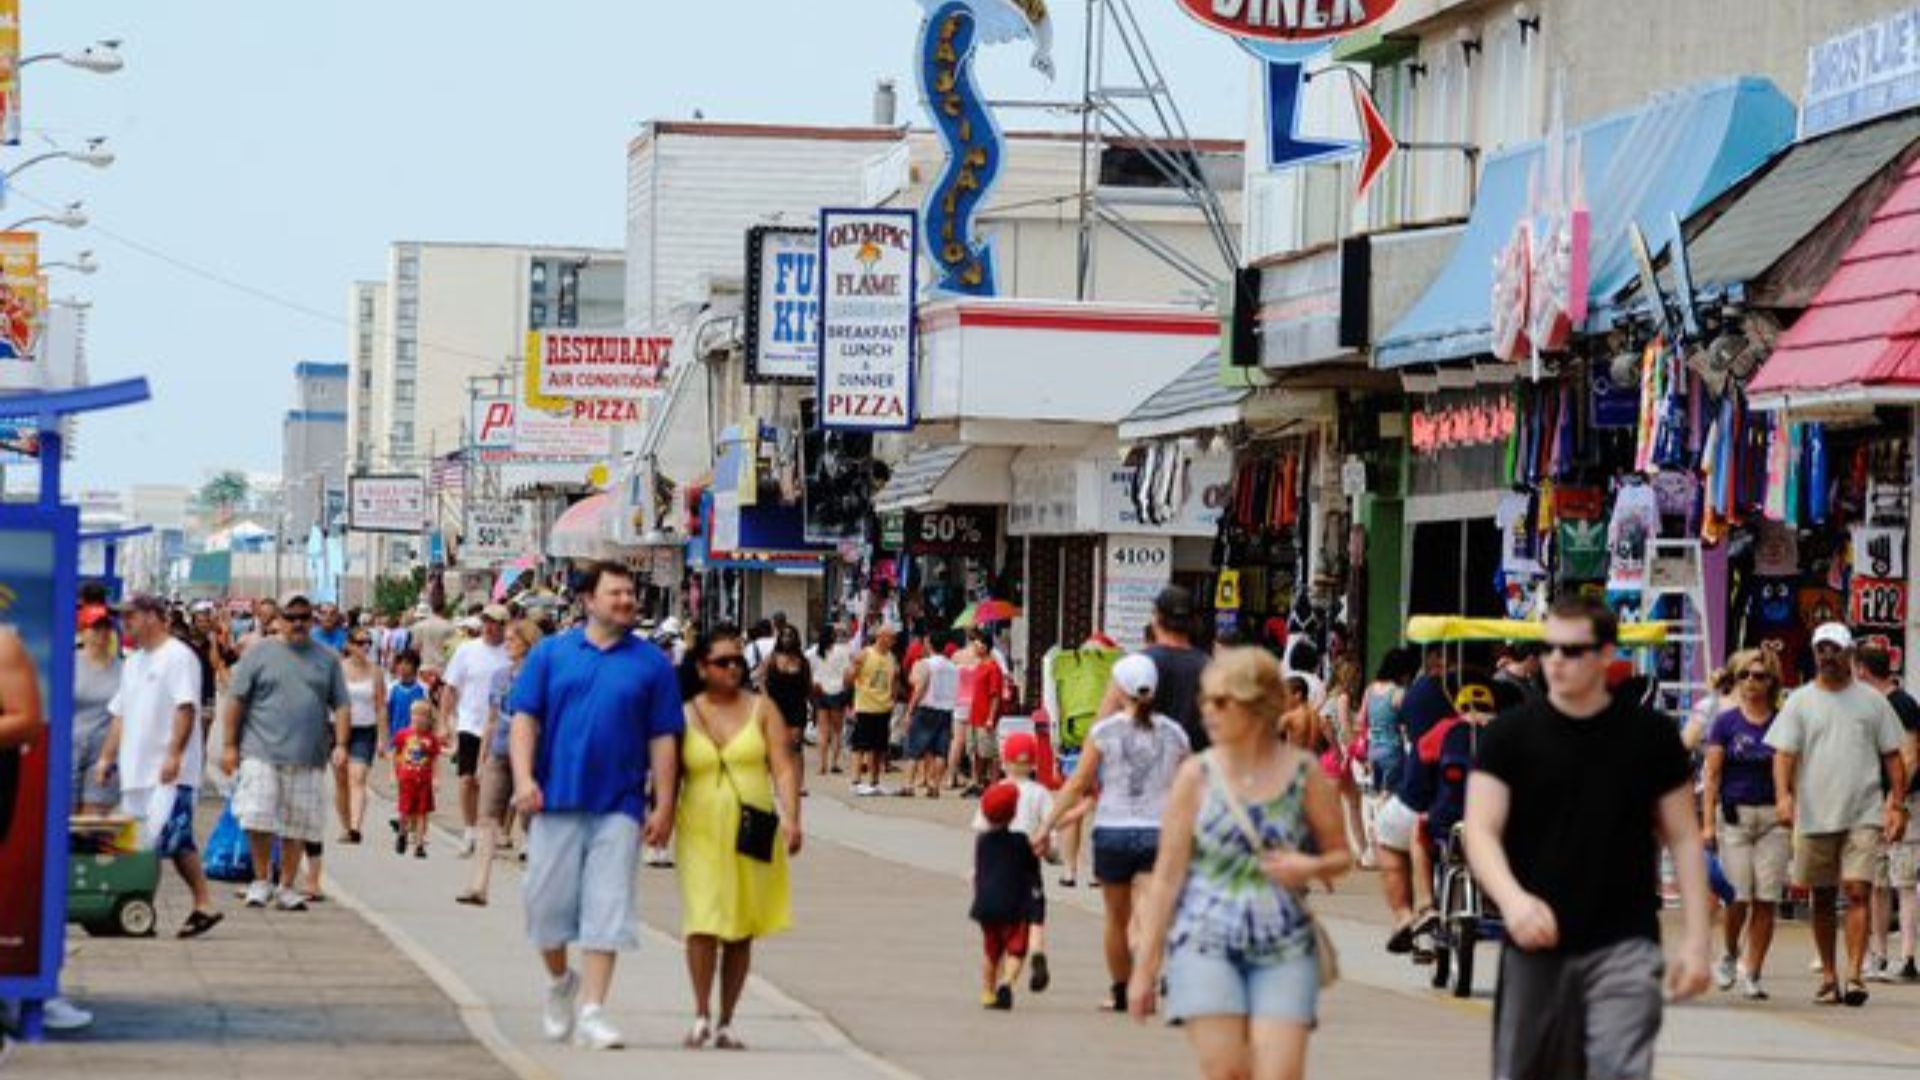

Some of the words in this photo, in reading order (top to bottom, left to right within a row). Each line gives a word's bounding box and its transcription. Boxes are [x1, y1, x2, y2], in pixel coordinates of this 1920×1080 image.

[828, 223, 909, 251] OLYMPIC
[774, 253, 817, 296] FU
[836, 274, 901, 296] FLAME
[827, 326, 905, 338] BREAKFAST
[546, 336, 672, 366] RESTAURANT
[840, 344, 892, 357] LUNCH
[549, 373, 573, 386] AIR
[838, 373, 894, 388] DINNER
[574, 400, 639, 420] PIZZA
[827, 394, 904, 416] PIZZA
[919, 514, 982, 542] 50%
[1113, 547, 1165, 565] 4100
